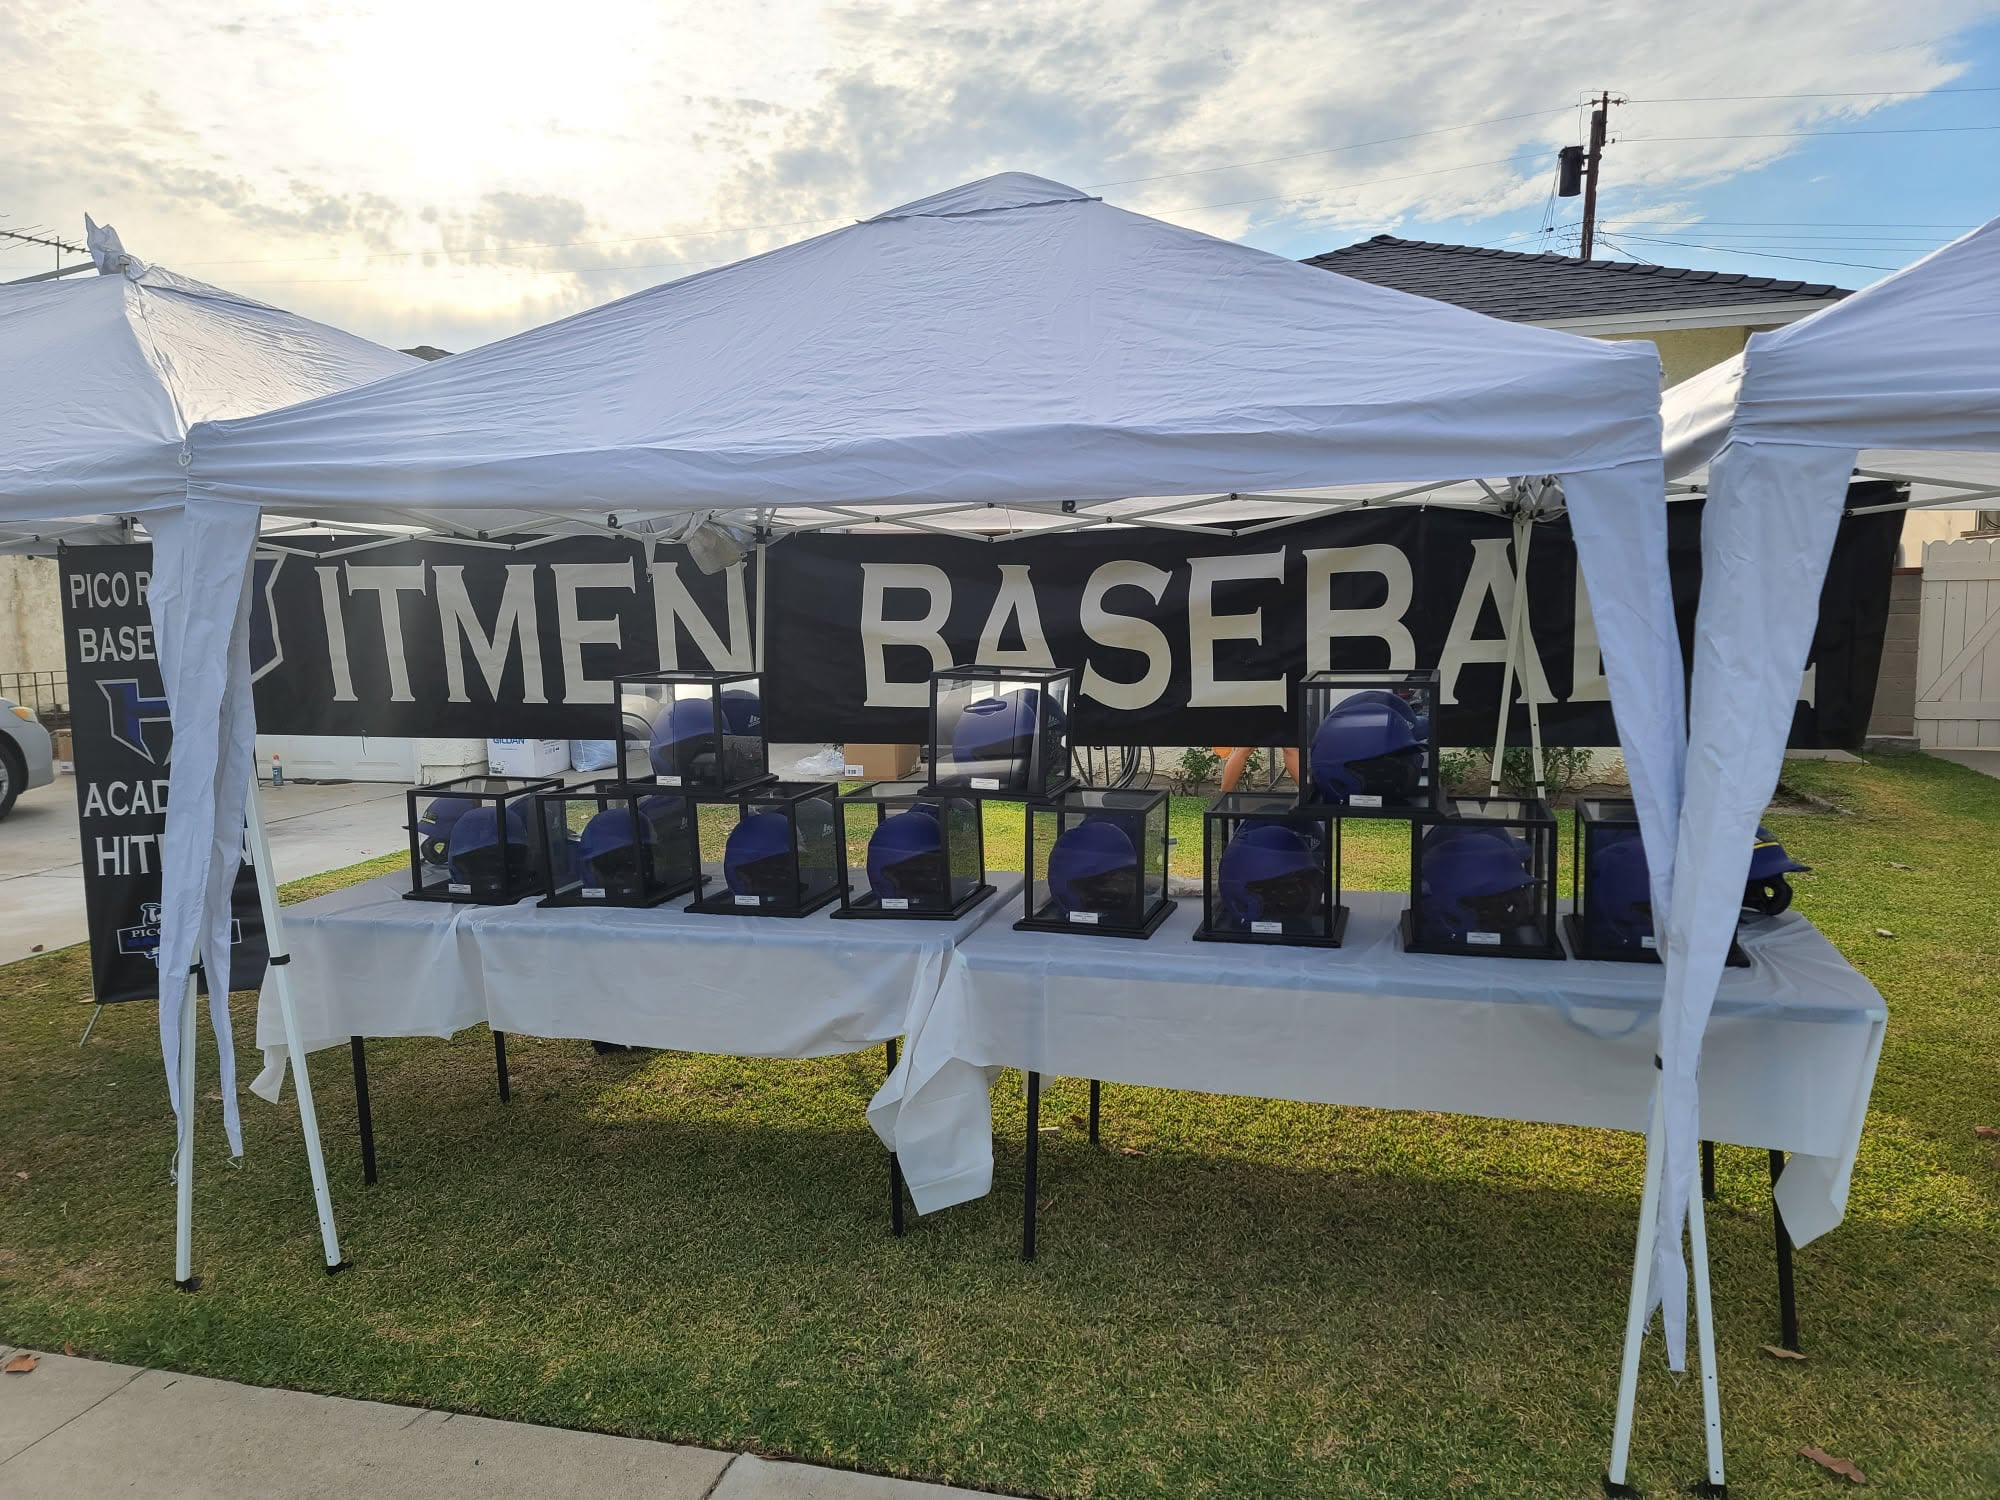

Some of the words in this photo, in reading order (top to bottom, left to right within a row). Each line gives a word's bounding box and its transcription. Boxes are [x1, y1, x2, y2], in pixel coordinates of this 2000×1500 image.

[69, 572, 130, 609] PICO
[861, 539, 1816, 711] BASEBAL
[78, 625, 156, 663] BASE
[82, 780, 169, 817] ACAD
